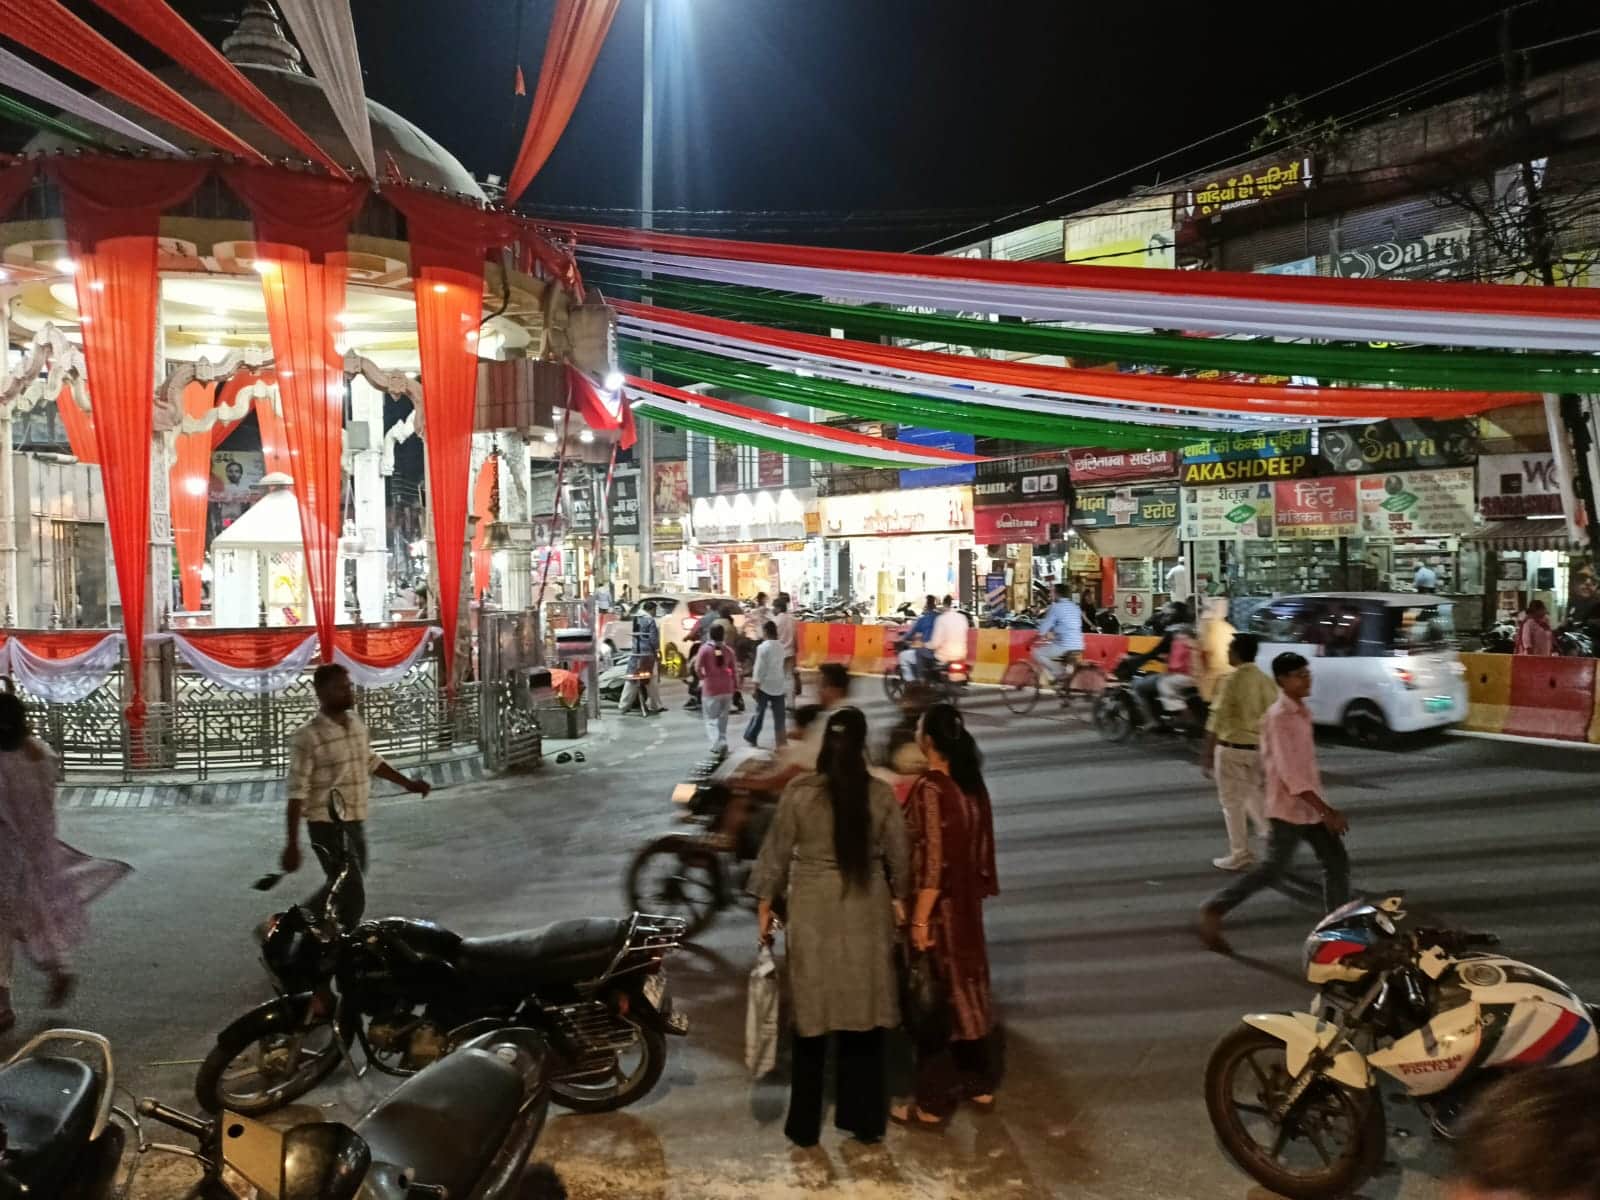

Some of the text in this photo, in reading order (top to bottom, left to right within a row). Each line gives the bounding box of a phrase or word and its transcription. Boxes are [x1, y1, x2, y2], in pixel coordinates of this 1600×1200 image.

[1238, 174, 1254, 198] ही
[1358, 424, 1436, 463] Sara
[1185, 455, 1306, 481] AKASHDEEP
[1294, 481, 1336, 508] हिंद
[1142, 498, 1177, 519] स्टोर
[1403, 1060, 1456, 1074] POLICE
